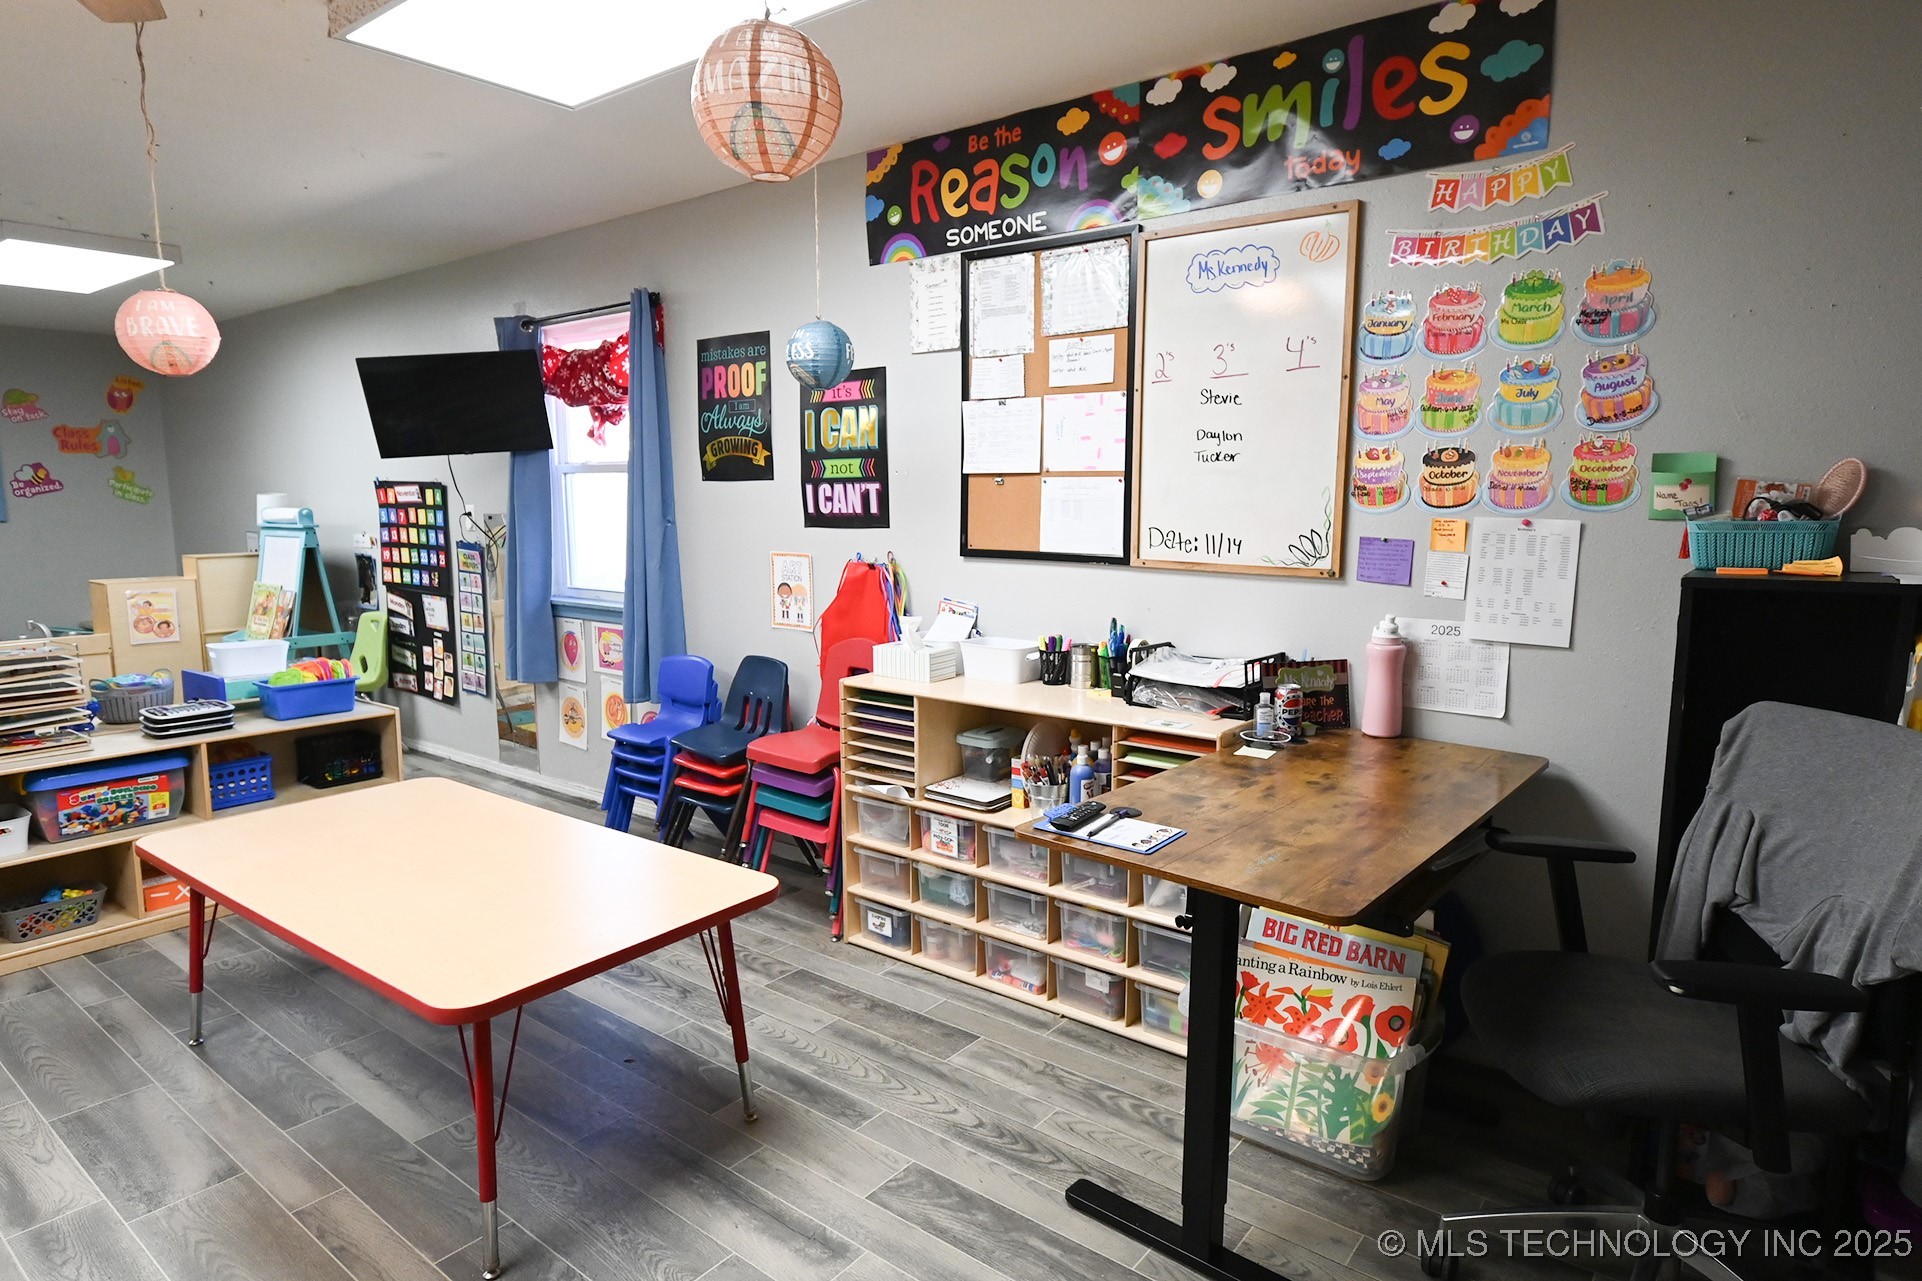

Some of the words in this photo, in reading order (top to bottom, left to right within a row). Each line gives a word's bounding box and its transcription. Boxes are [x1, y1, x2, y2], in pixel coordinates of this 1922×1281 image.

[1202, 34, 1471, 161] smiles
[968, 134, 988, 153] Be
[994, 124, 1022, 148] the
[1284, 148, 1362, 181] today
[910, 142, 1090, 225] Reason
[1436, 160, 1559, 202] HAPPY
[945, 210, 1048, 247] SOMEONE
[1398, 209, 1591, 257] BIRTHDAY
[1199, 260, 1216, 281] Ms
[1217, 256, 1268, 278] Kennedy
[1601, 291, 1634, 307] April
[1513, 302, 1552, 313] March
[1367, 319, 1408, 330] January
[1432, 313, 1475, 323] February
[126, 316, 200, 337] BRAVE
[700, 346, 746, 362] mistakes
[747, 345, 767, 357] are
[1212, 342, 1235, 376] 3's
[1286, 336, 1317, 369] 4's
[702, 361, 767, 400] PROOF
[1594, 375, 1638, 393] August
[832, 385, 852, 399] it's
[1200, 388, 1243, 406] Stevie
[1516, 388, 1540, 400] July
[738, 402, 750, 410] am
[1376, 397, 1396, 408] May
[1, 407, 25, 417] Stay
[701, 404, 768, 437] Always
[804, 409, 816, 452] I
[820, 404, 880, 452] CAN
[52, 427, 90, 439] Class
[60, 440, 99, 451] Rules
[710, 438, 759, 458] GROWING
[1193, 450, 1241, 463] Tucker
[831, 463, 854, 475] not
[1429, 470, 1469, 480] October
[1498, 469, 1543, 477] November
[1580, 464, 1628, 473] December
[11, 481, 25, 489] Be
[14, 482, 63, 497] organized.
[805, 482, 816, 515] I
[818, 482, 881, 517] CAN'T
[1656, 491, 1679, 500] Name
[382, 532, 389, 540] 12
[1148, 527, 1198, 553] Date:
[1205, 533, 1242, 557] 11/14
[383, 551, 390, 559] 19
[420, 553, 428, 562] 23
[430, 554, 437, 563] 24
[782, 560, 803, 575] ART
[422, 574, 430, 583] 30
[781, 573, 803, 582] STATION
[1431, 624, 1461, 637] 2025
[1262, 917, 1299, 946] BIG
[1301, 928, 1345, 957] RED
[1346, 940, 1407, 975] BARN
[1278, 964, 1286, 974] a
[1288, 962, 1348, 985] Rainbow
[1350, 978, 1360, 988] by
[1361, 978, 1379, 990] Lois
[1379, 982, 1403, 993] Ehlert
